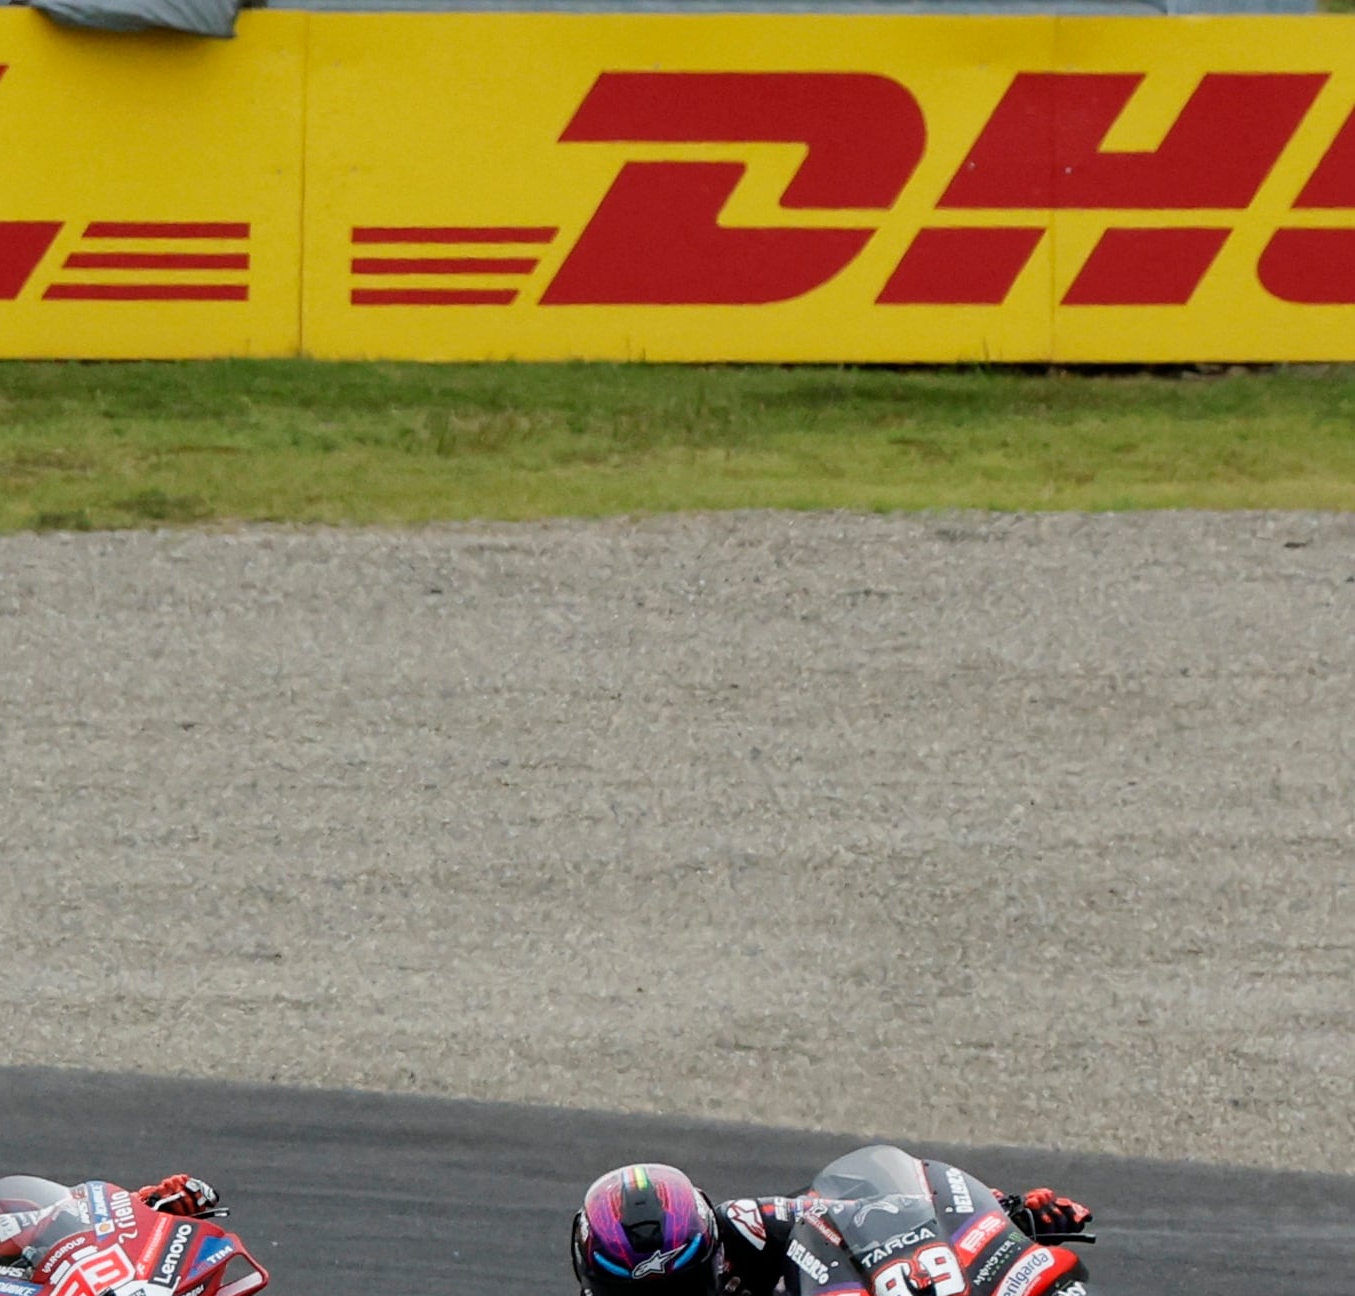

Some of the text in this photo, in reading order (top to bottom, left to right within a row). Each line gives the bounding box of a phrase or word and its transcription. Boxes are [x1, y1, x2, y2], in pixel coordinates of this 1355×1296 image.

[110, 1191, 136, 1228] riello
[861, 1227, 936, 1267] TARGA
[959, 1215, 1002, 1253] BS
[154, 1224, 191, 1284] Lenovo
[207, 1246, 234, 1265] TIM
[973, 1239, 1016, 1286] MONSTER
